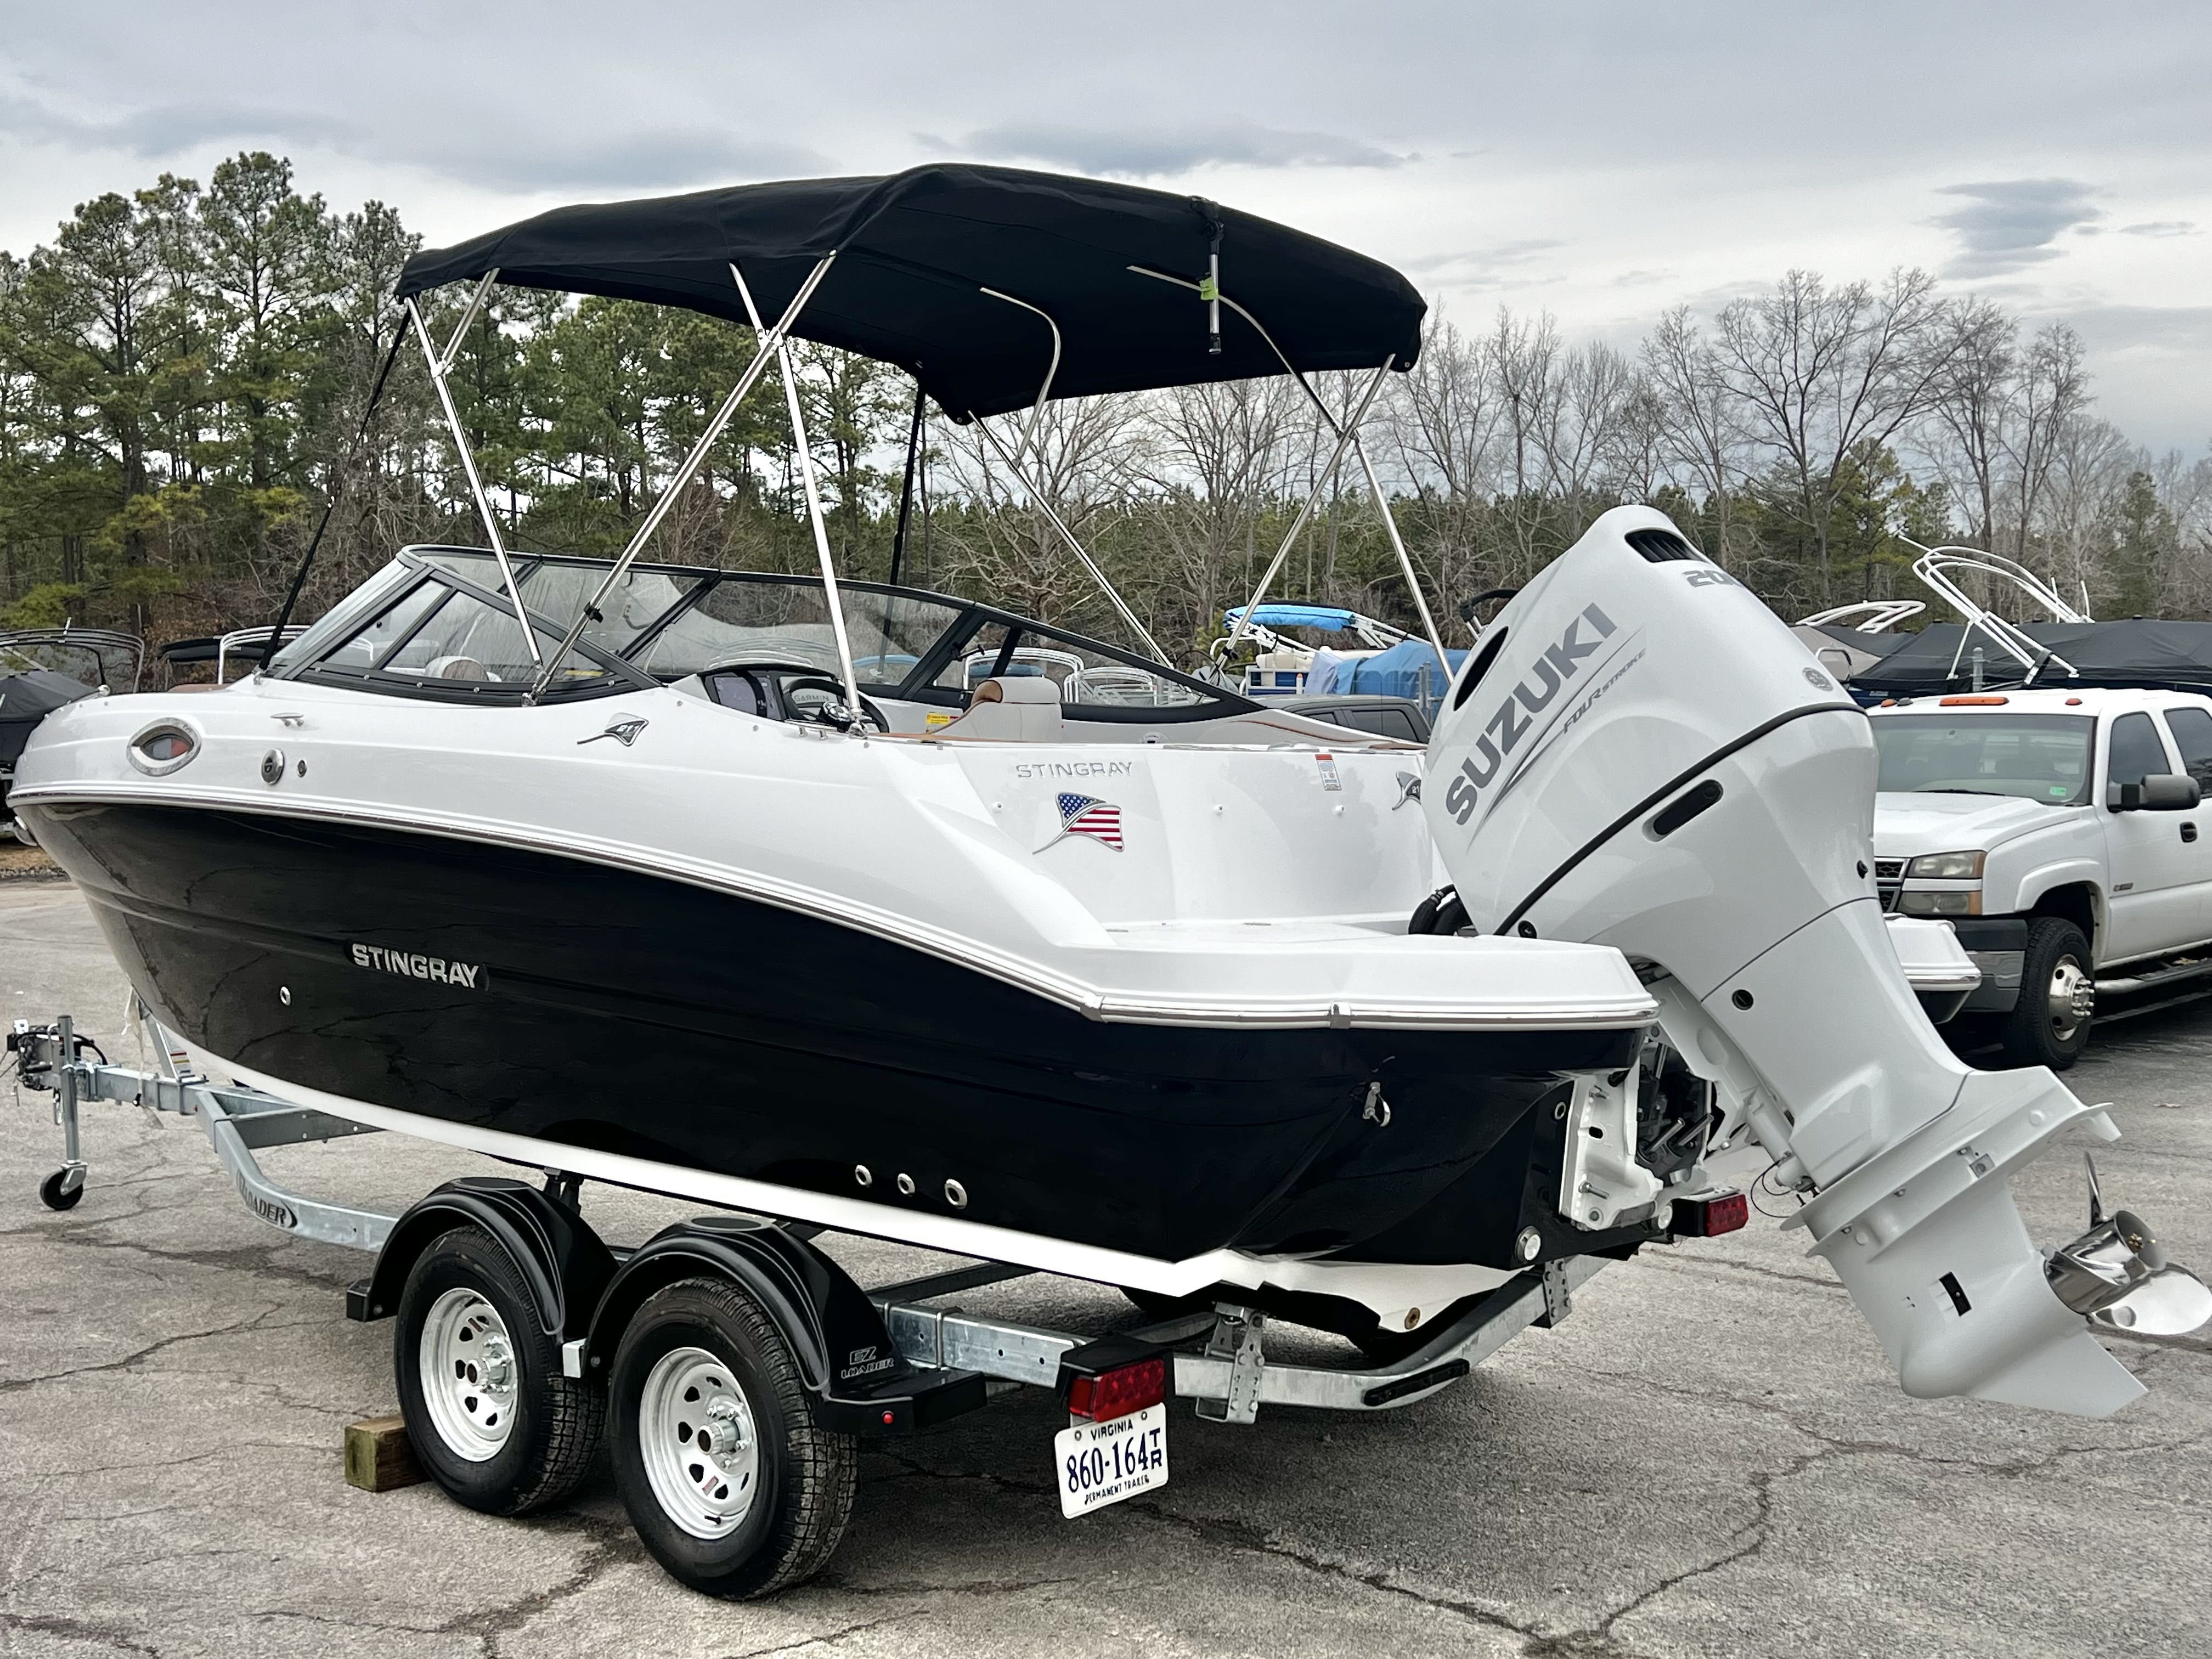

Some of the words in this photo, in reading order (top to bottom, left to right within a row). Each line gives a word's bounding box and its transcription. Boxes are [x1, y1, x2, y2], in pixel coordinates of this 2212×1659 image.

[1682, 569, 1745, 588] 20
[1564, 687, 1602, 733] FOUR
[1602, 648, 1646, 693] STROKE
[1446, 602, 1617, 825] SUZUKI
[1015, 761, 1132, 778] STINGRAY
[352, 943, 479, 988] STINGRAY
[850, 1346, 877, 1365] EZ
[841, 1358, 894, 1379] LOADER
[1091, 1419, 1133, 1441] VIRGINIA
[1066, 1432, 1148, 1493] 860-164
[1085, 1483, 1122, 1505] PERMANENT
